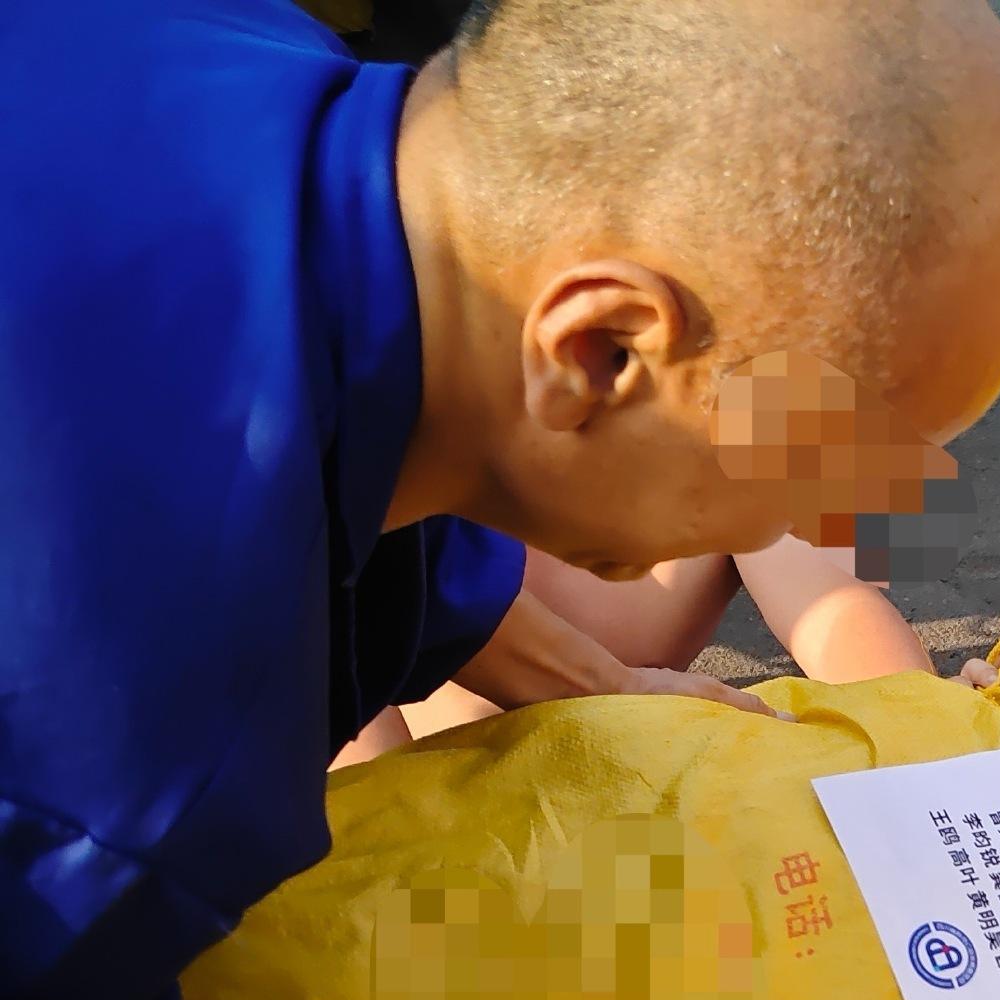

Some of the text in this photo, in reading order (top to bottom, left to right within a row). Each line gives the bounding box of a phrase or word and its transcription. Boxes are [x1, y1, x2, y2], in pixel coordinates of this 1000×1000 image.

[928, 808, 961, 846] 王鸥
[947, 847, 980, 886] 高叶
[773, 852, 834, 959] 电话:
